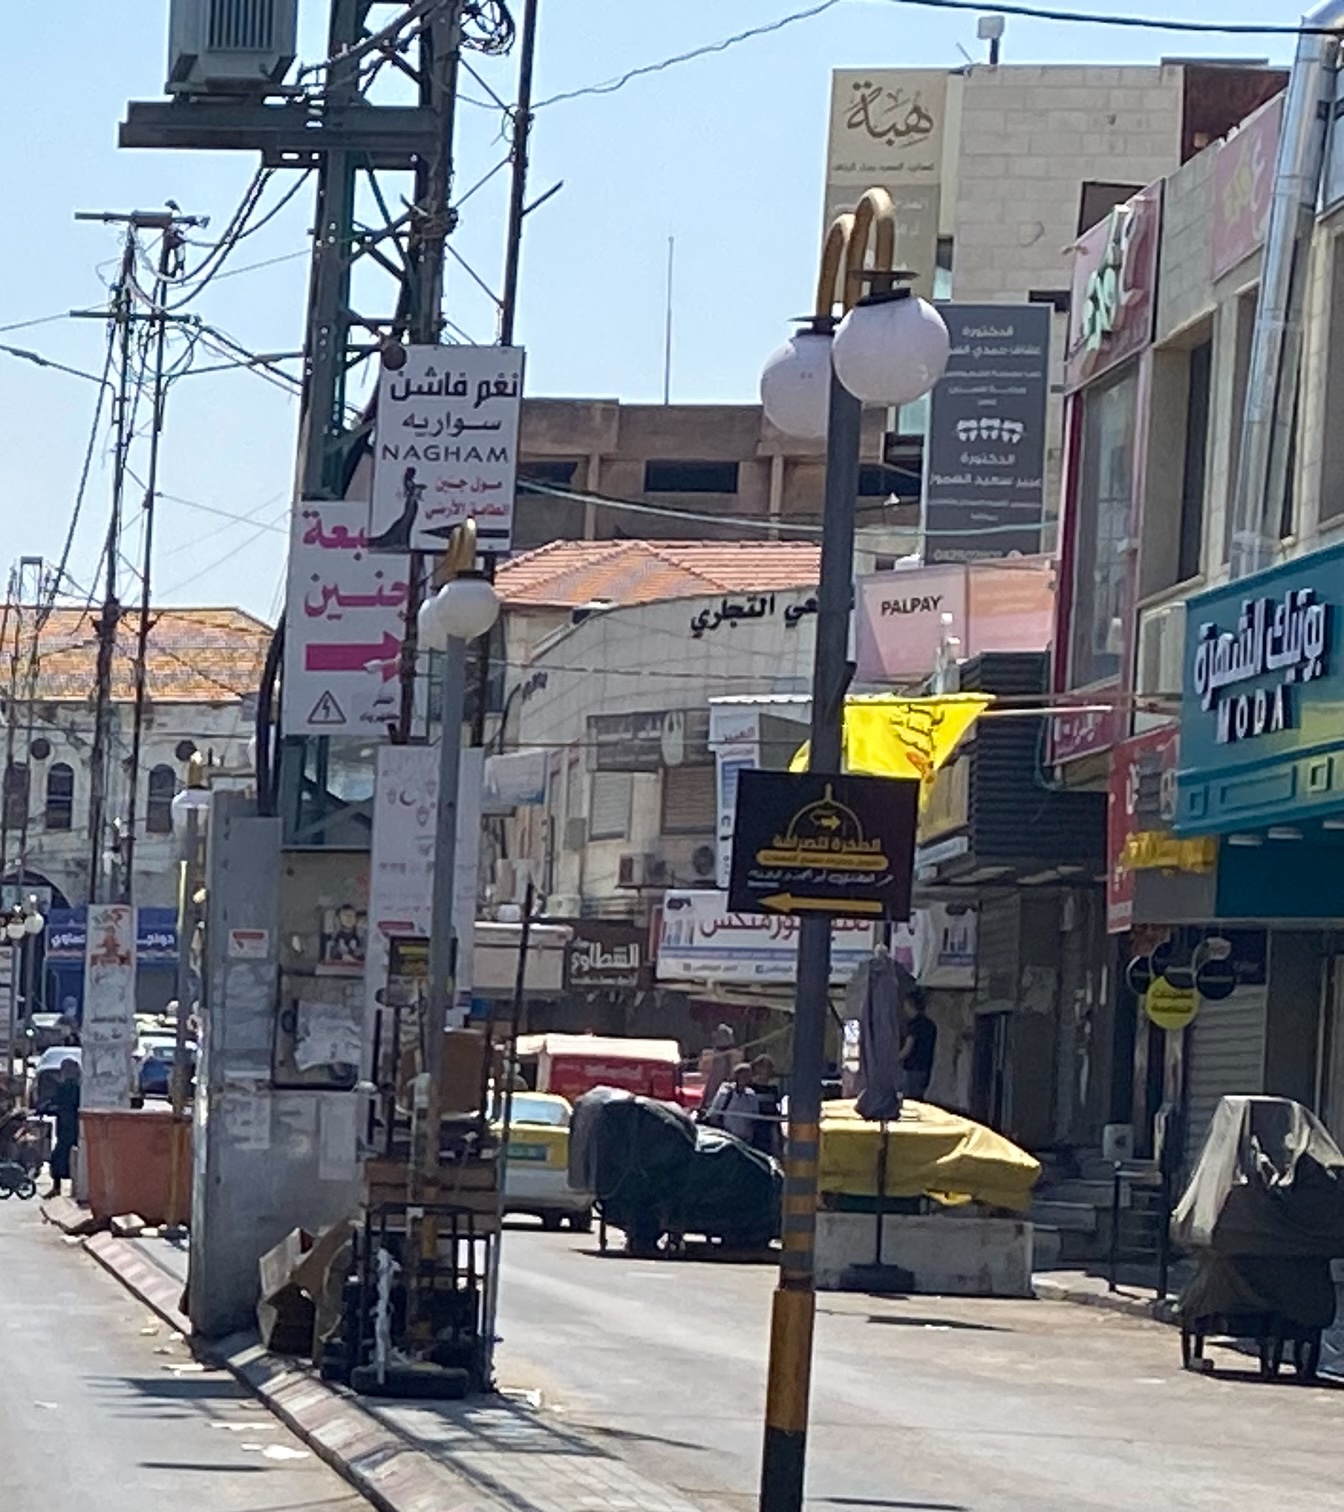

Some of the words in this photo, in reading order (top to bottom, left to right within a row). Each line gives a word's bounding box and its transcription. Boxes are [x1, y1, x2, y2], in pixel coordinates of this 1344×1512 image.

[390, 365, 469, 402] فاشن
[473, 371, 521, 409] نغم
[380, 443, 510, 464] NAGHAM
[689, 592, 776, 639] التجاري
[880, 594, 944, 617] PALPAY
[1217, 683, 1286, 744] MODA
